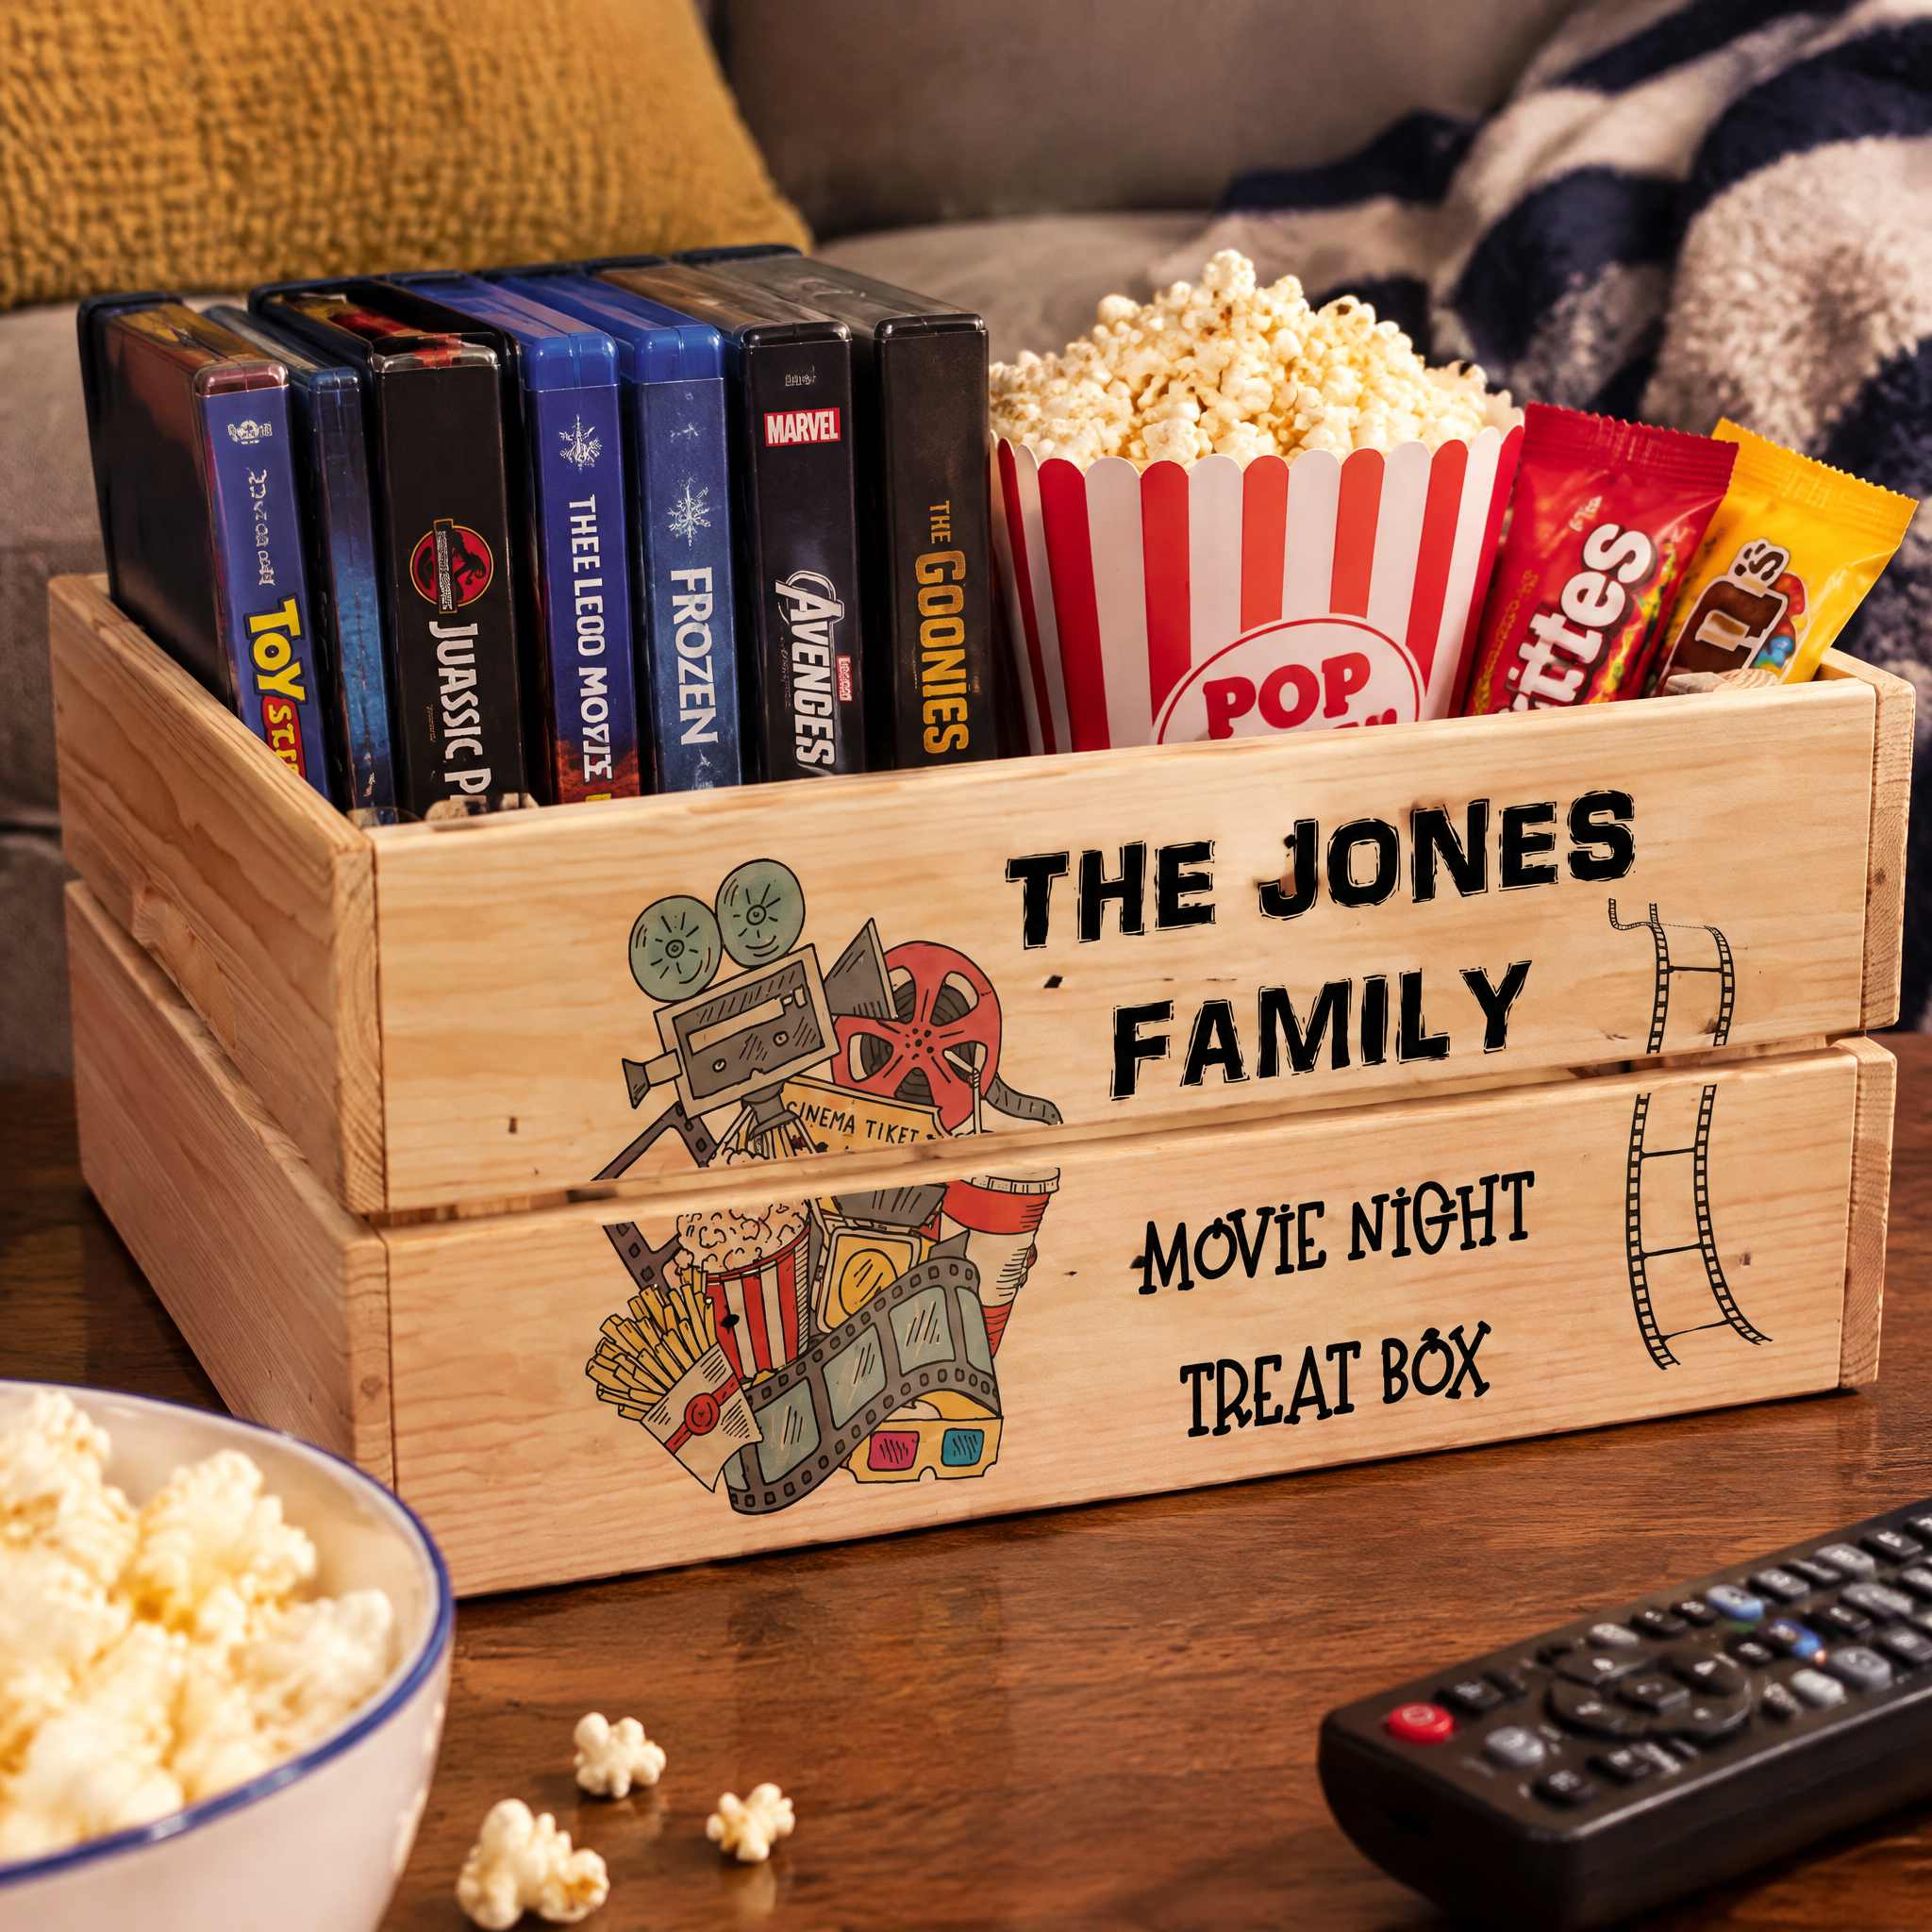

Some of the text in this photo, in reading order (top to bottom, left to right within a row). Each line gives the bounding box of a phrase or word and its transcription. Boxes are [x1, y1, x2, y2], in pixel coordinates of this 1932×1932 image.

[767, 410, 838, 445] MARVEL
[569, 493, 601, 574] THEE
[428, 621, 486, 759] JUASSIC
[671, 567, 719, 745] FROZEN
[775, 571, 843, 766] AVENGES
[915, 500, 970, 754] THE GOONIES
[1203, 652, 1371, 741] POP
[1006, 790, 1636, 950] THE JONES
[1109, 959, 1532, 1101] FAMILY
[866, 1119, 920, 1144] TIKET
[1179, 1321, 1492, 1439] TREAT BOX
